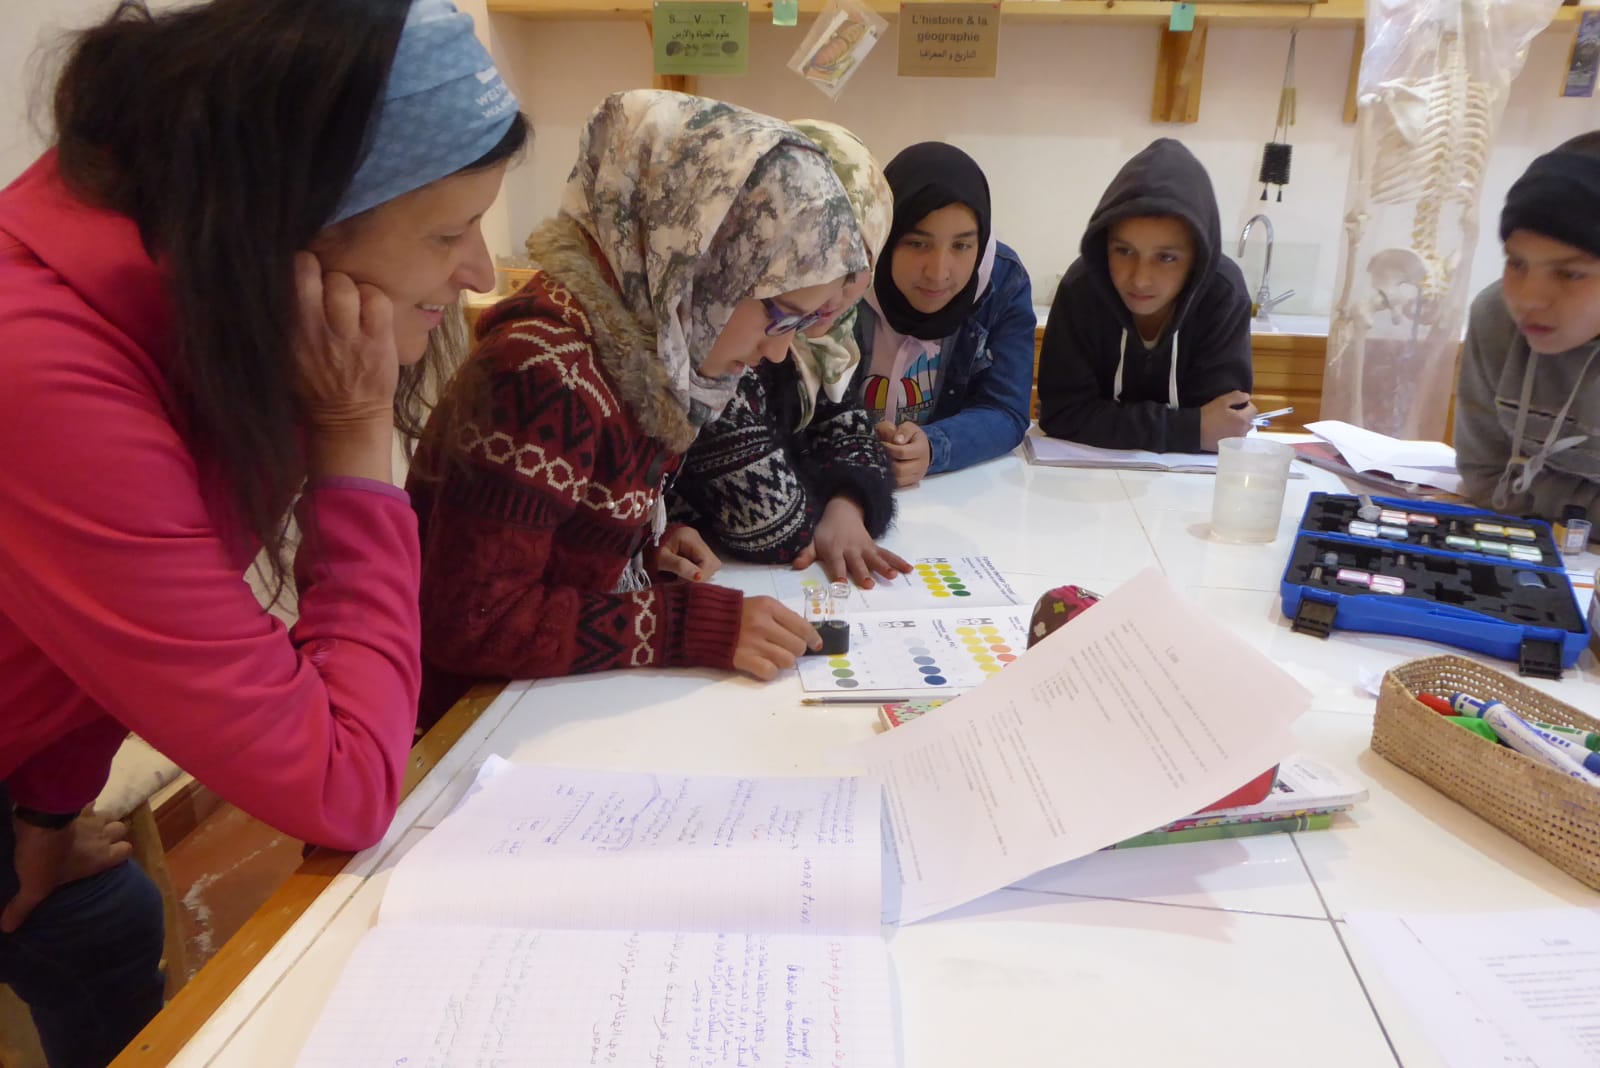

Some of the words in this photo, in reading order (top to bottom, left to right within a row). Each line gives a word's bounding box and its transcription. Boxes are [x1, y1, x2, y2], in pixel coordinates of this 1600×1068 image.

[912, 15, 964, 25] L'histoire
[966, 15, 975, 25] &
[977, 15, 988, 26] la
[917, 31, 980, 43] géographie
